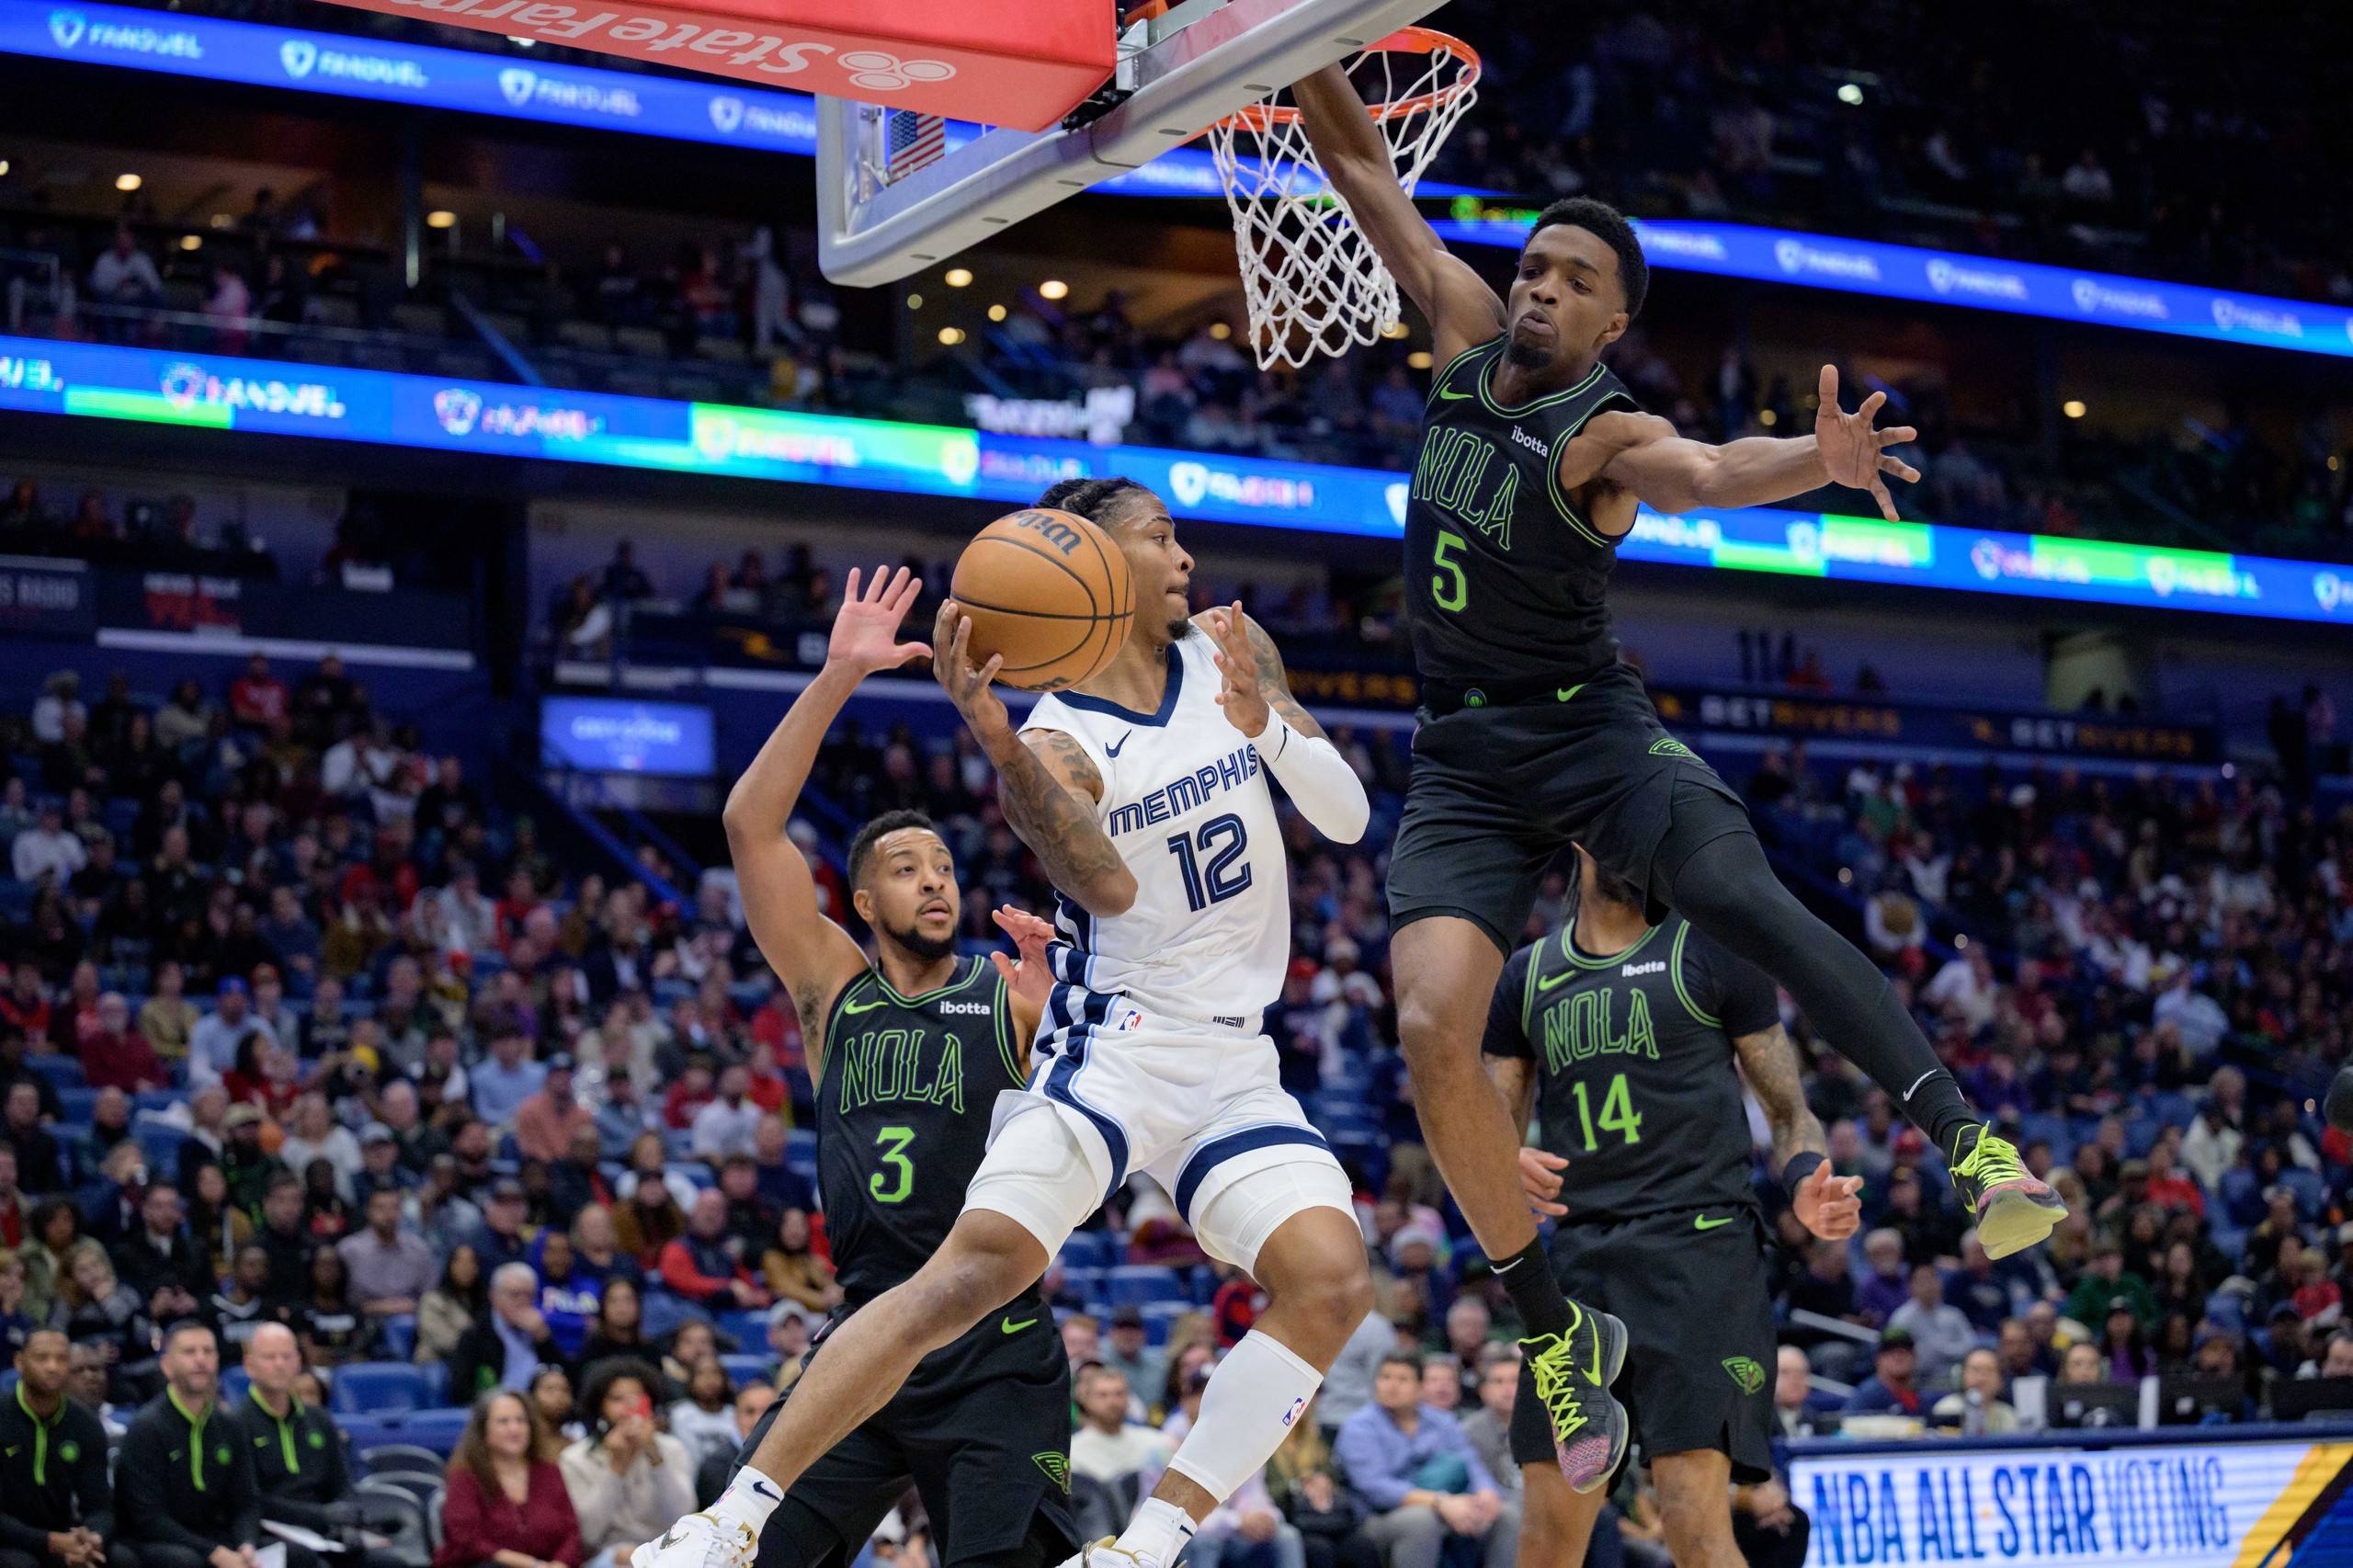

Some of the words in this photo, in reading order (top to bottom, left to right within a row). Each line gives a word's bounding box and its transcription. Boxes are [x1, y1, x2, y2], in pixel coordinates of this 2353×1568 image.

[1511, 426, 1549, 458] ibotta
[1413, 426, 1519, 551] NOLA
[1432, 529, 1468, 612] 5
[1109, 743, 1258, 837] MEMPHIS
[1167, 812, 1252, 913] 12
[939, 1001, 991, 1015] ibotta
[1621, 961, 1665, 977] ibotta
[840, 1029, 964, 1114] NOLA
[1543, 987, 1660, 1076] NOLA
[1572, 1074, 1643, 1151] 14
[870, 1126, 915, 1202] 3
[1813, 1471, 1905, 1566] NBA
[1918, 1467, 1984, 1561] ALL
[1994, 1464, 2099, 1557] STAR
[2103, 1457, 2230, 1551] VOTING
